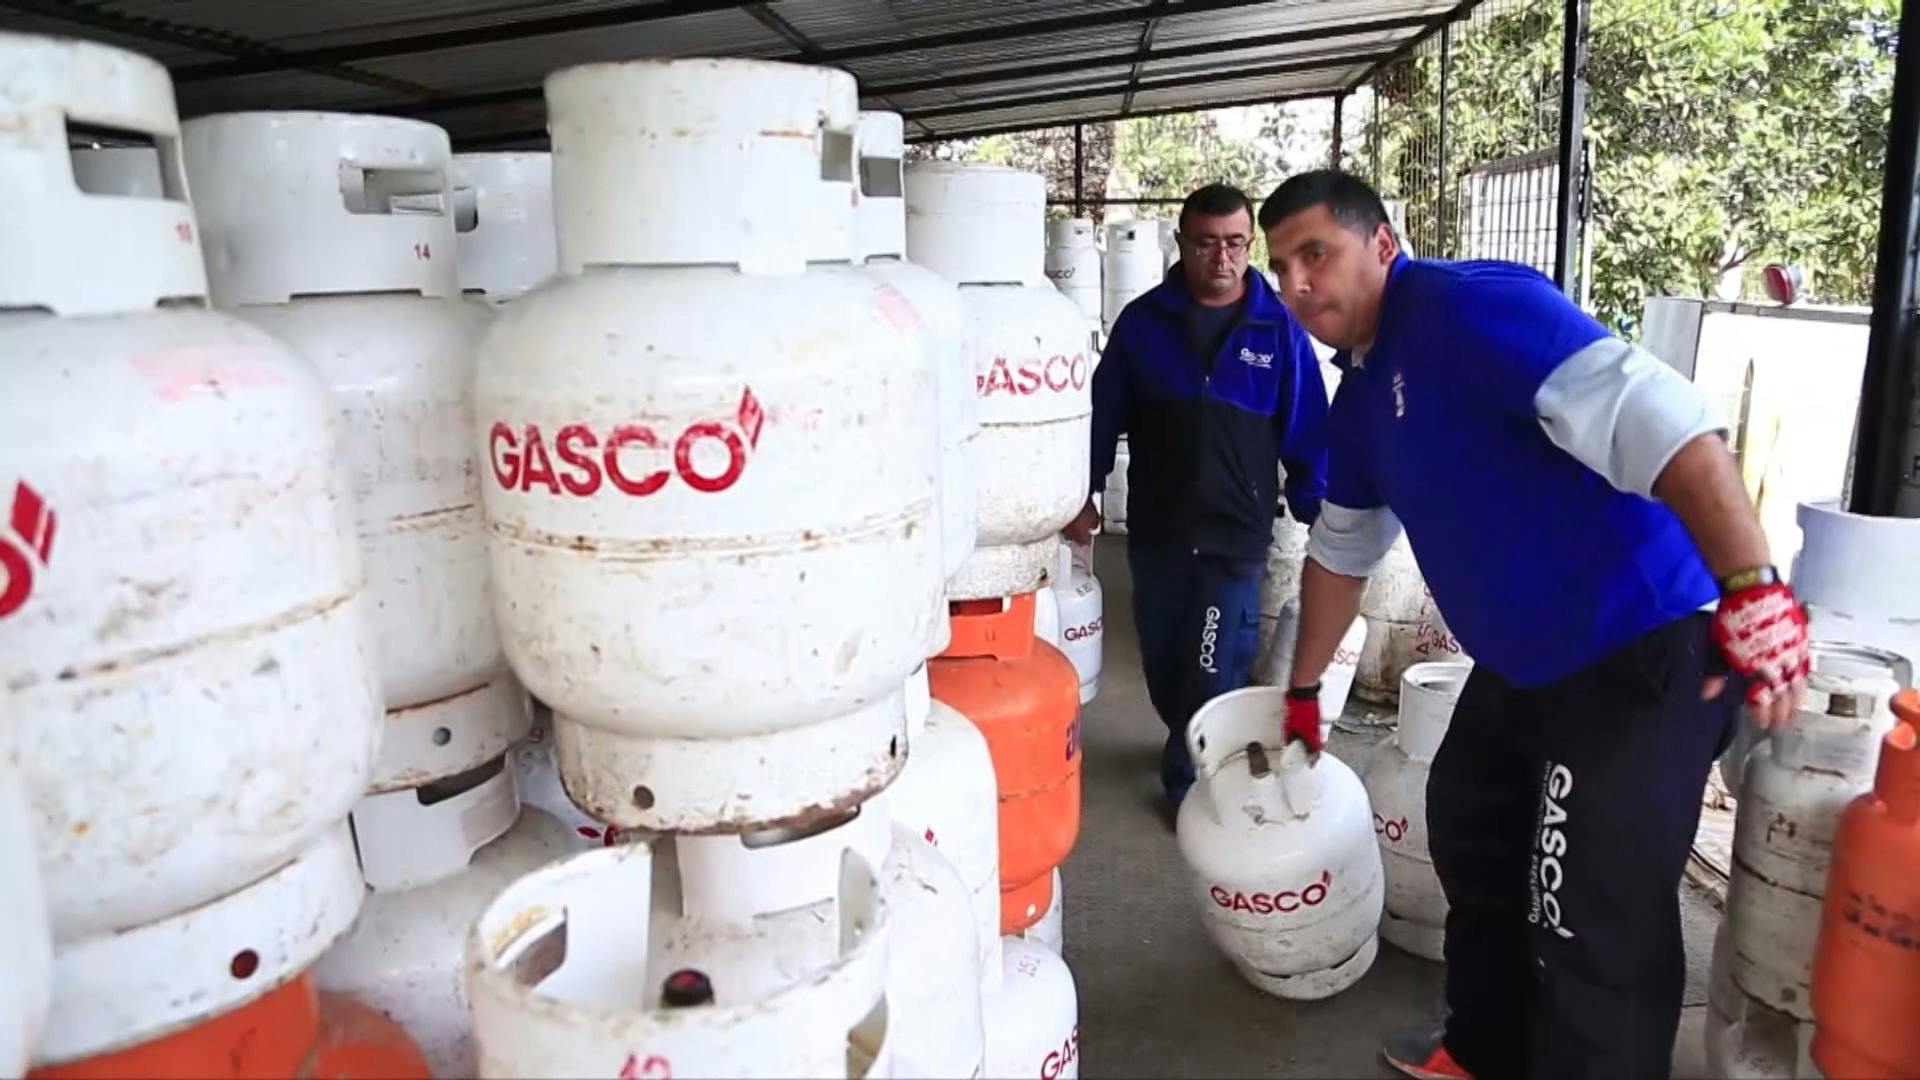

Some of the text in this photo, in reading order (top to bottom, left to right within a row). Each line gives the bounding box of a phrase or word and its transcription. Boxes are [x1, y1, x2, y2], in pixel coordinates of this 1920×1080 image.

[414, 242, 431, 260] 14
[489, 421, 745, 497] GASCO
[1200, 606, 1220, 669] GASCO
[1541, 764, 1573, 930] GASCO
[1210, 883, 1327, 915] GASCO
